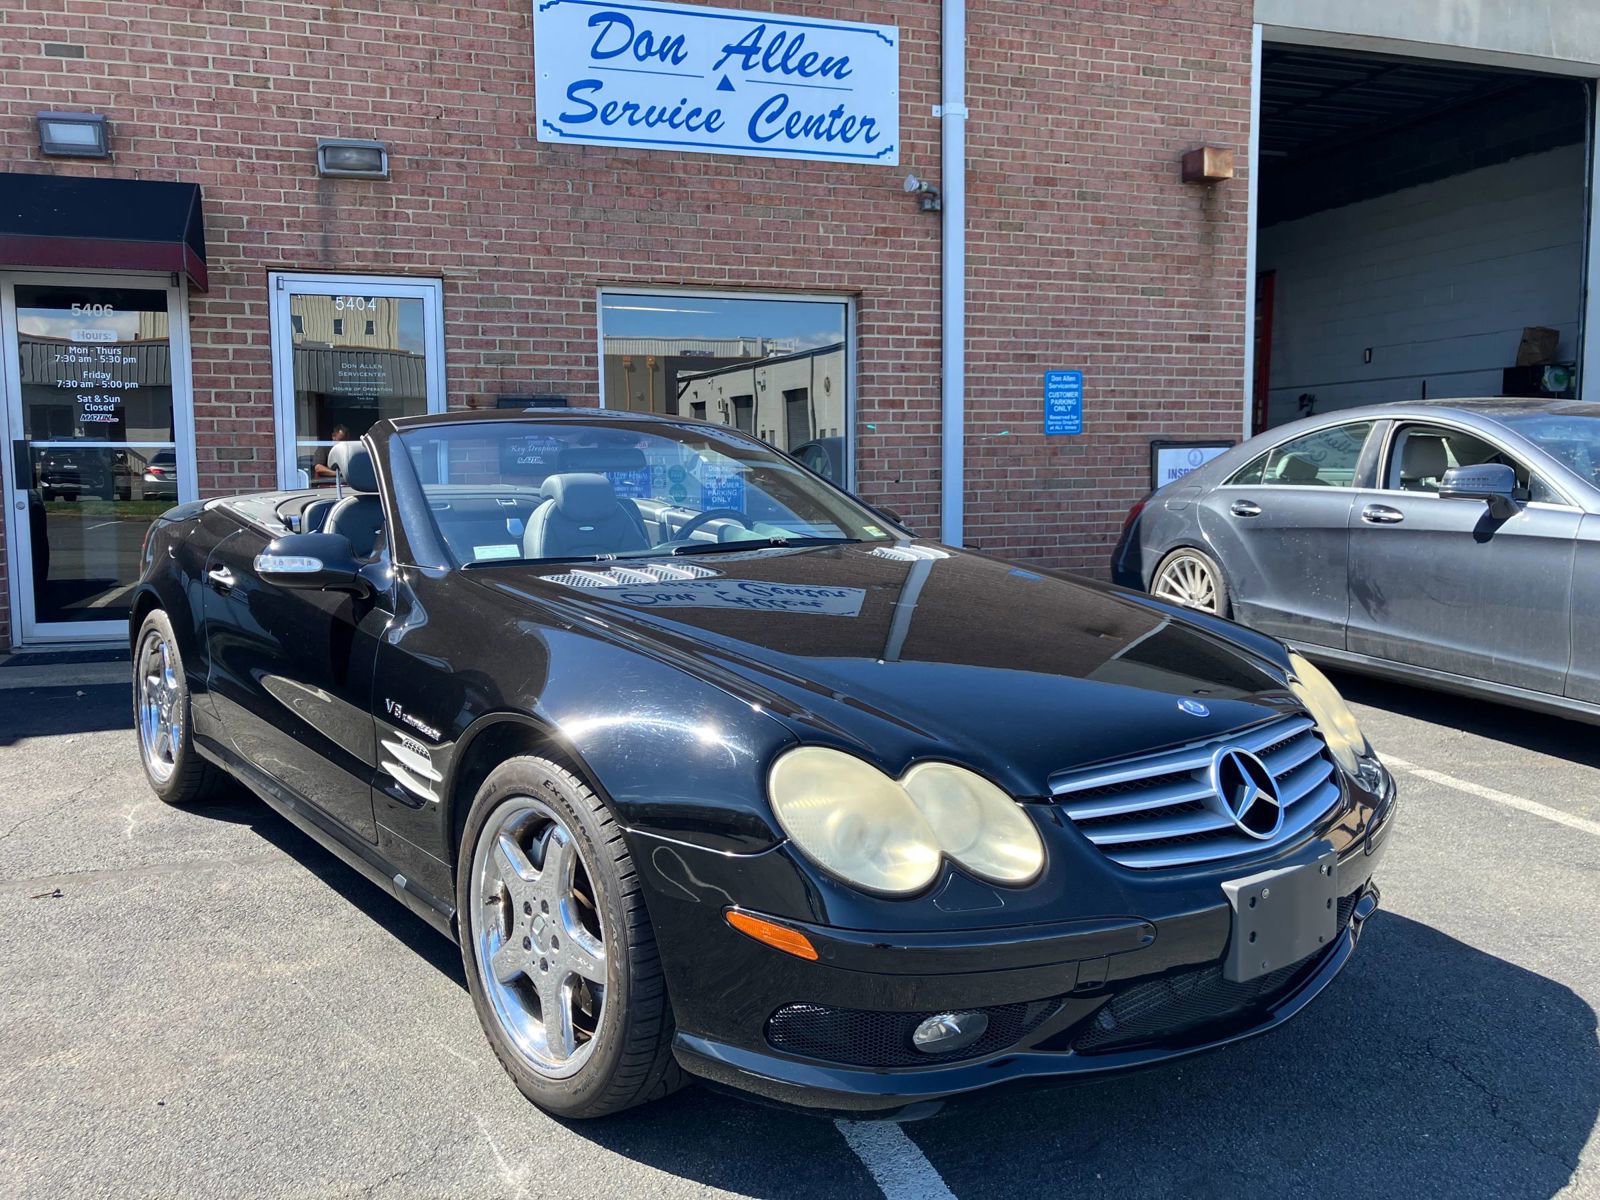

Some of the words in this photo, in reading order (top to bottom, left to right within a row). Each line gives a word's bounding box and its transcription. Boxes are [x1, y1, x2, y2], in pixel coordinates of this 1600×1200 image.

[588, 11, 688, 66] Don
[713, 24, 852, 79] Allen
[559, 79, 725, 133] Service
[747, 93, 881, 144] Center
[335, 296, 376, 311] 5404
[71, 303, 113, 317] 5406
[77, 331, 112, 340] Hours:
[69, 346, 88, 354] Mon
[96, 346, 122, 355] Thurs
[55, 355, 76, 363] 7:30
[100, 355, 121, 363] 5:30
[123, 357, 137, 365] pm
[83, 371, 111, 380] Friday
[57, 380, 78, 388] 7:30
[102, 380, 122, 388] 5:00
[124, 382, 139, 390] pm
[76, 395, 92, 403] Sat
[94, 395, 101, 403] &
[103, 395, 121, 403] Sun
[84, 403, 115, 411] Closed
